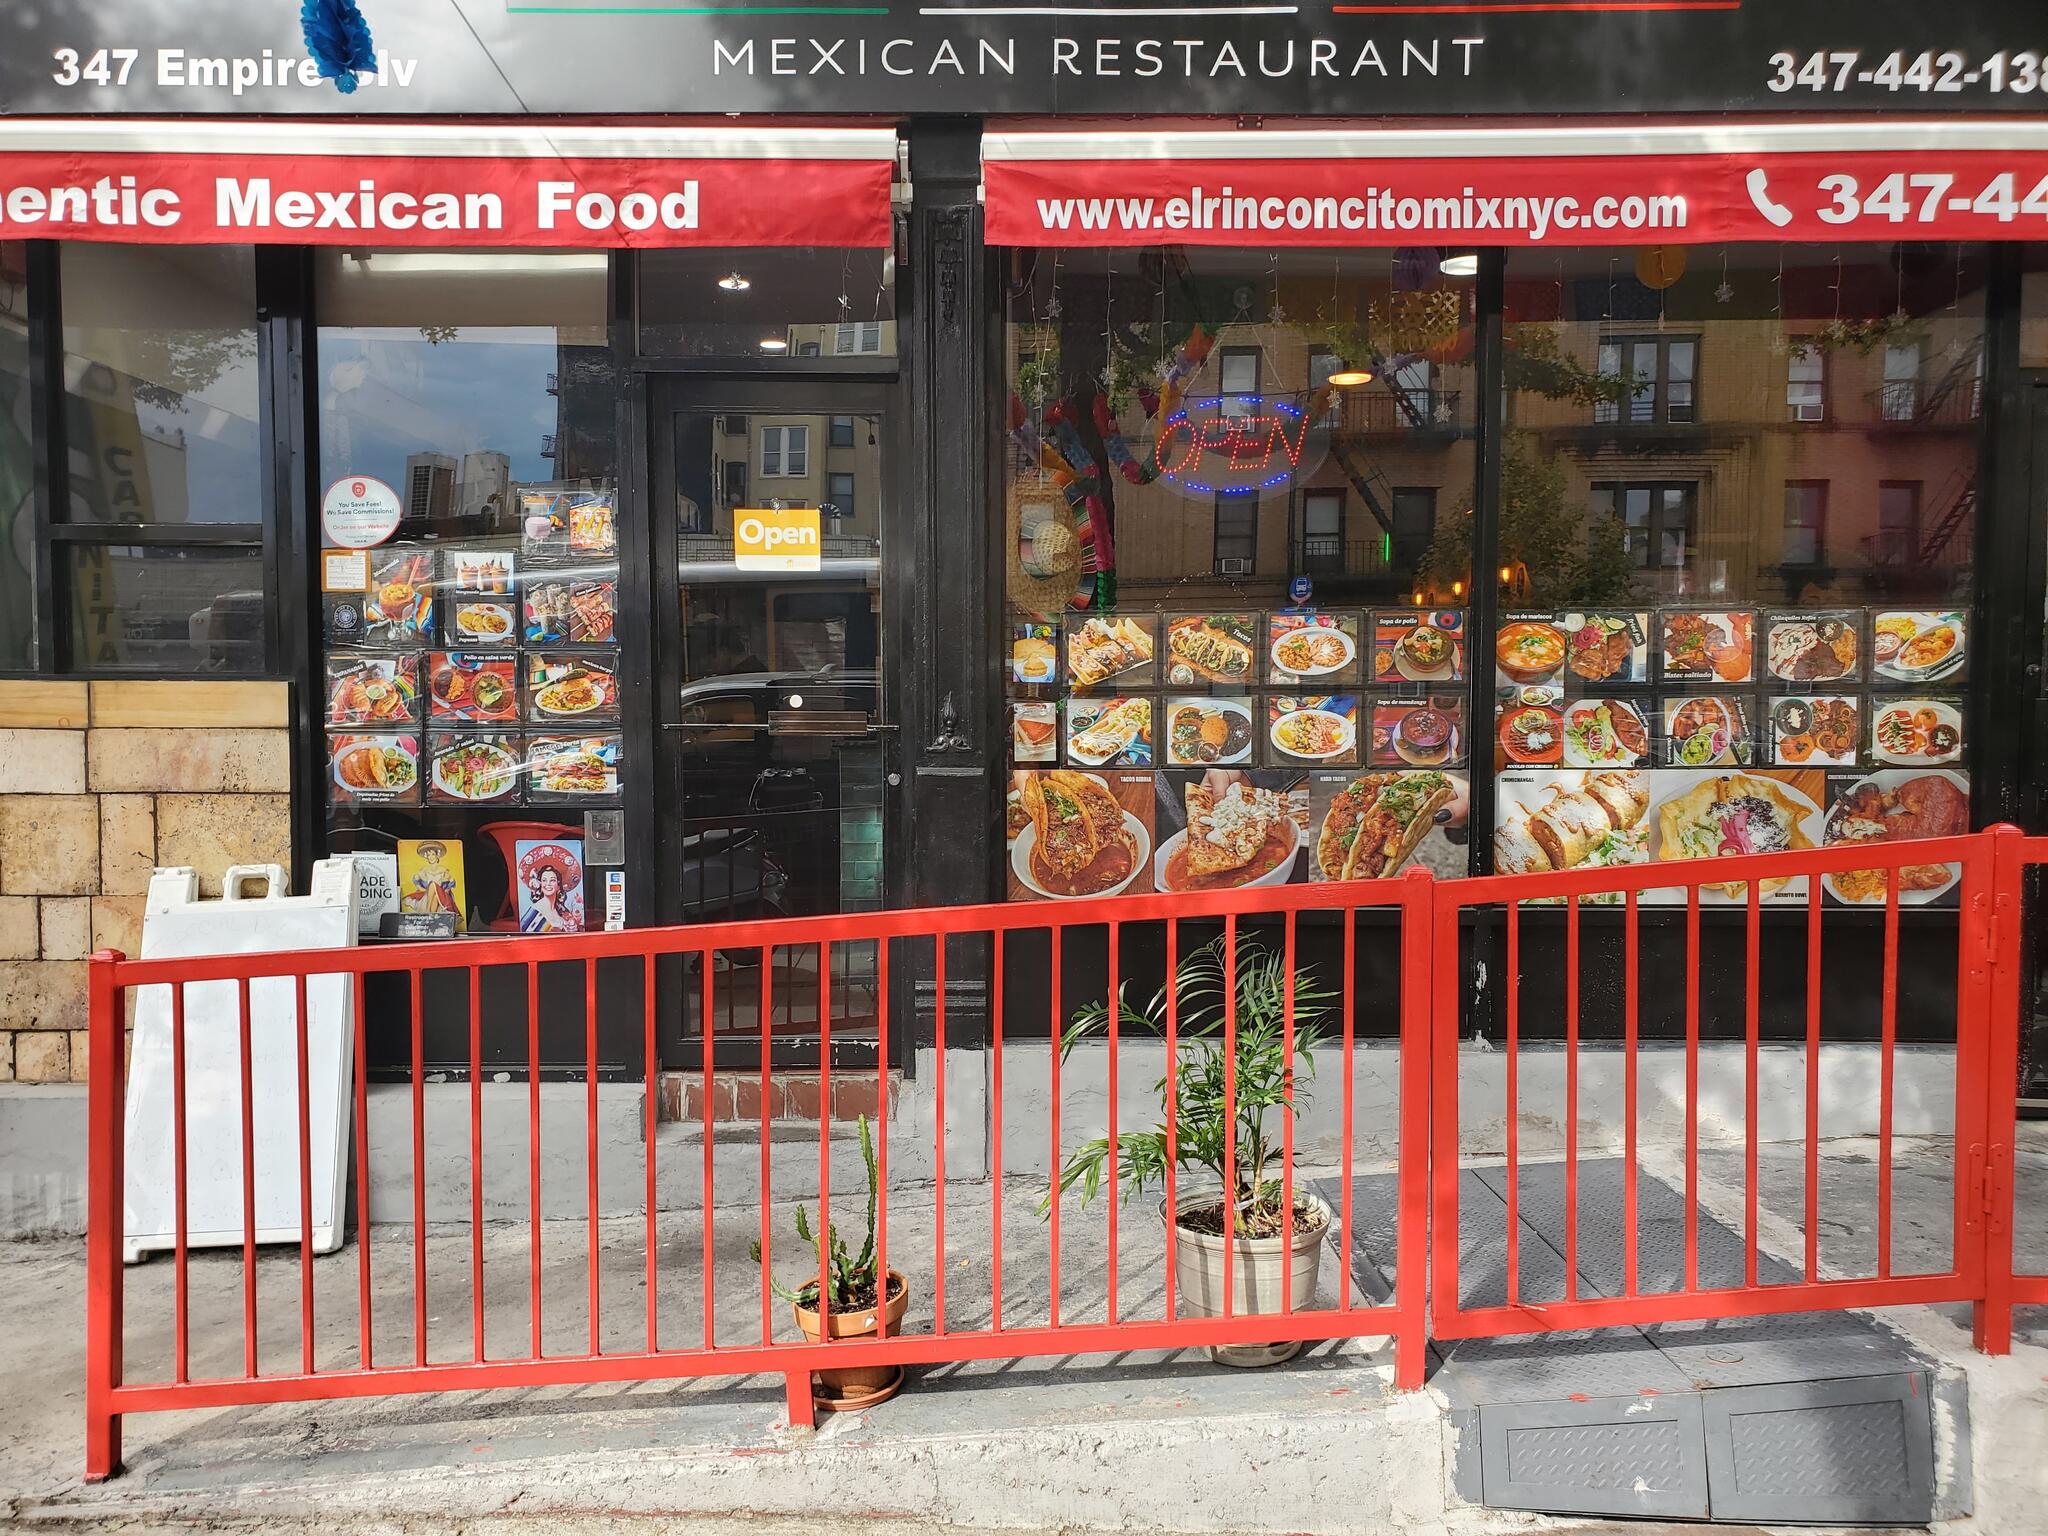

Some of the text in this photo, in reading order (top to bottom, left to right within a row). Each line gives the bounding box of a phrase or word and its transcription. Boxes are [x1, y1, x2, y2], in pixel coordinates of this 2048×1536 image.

[53, 48, 139, 87] 347
[157, 48, 324, 96] Empire
[713, 38, 1485, 77] MEXICAN RESTAURANT
[1766, 51, 2048, 94] 347-442-13
[0, 176, 699, 230] entic Mexican Food
[1037, 186, 1687, 240] www.elrinconcitomixnyc.com
[1155, 414, 1311, 474] OPEN
[739, 518, 817, 551] Open
[1233, 628, 1252, 643] Tacos
[1379, 618, 1394, 626] Sopa
[1402, 617, 1418, 625] pollo
[360, 876, 386, 887] ADE
[360, 888, 392, 899] DING
